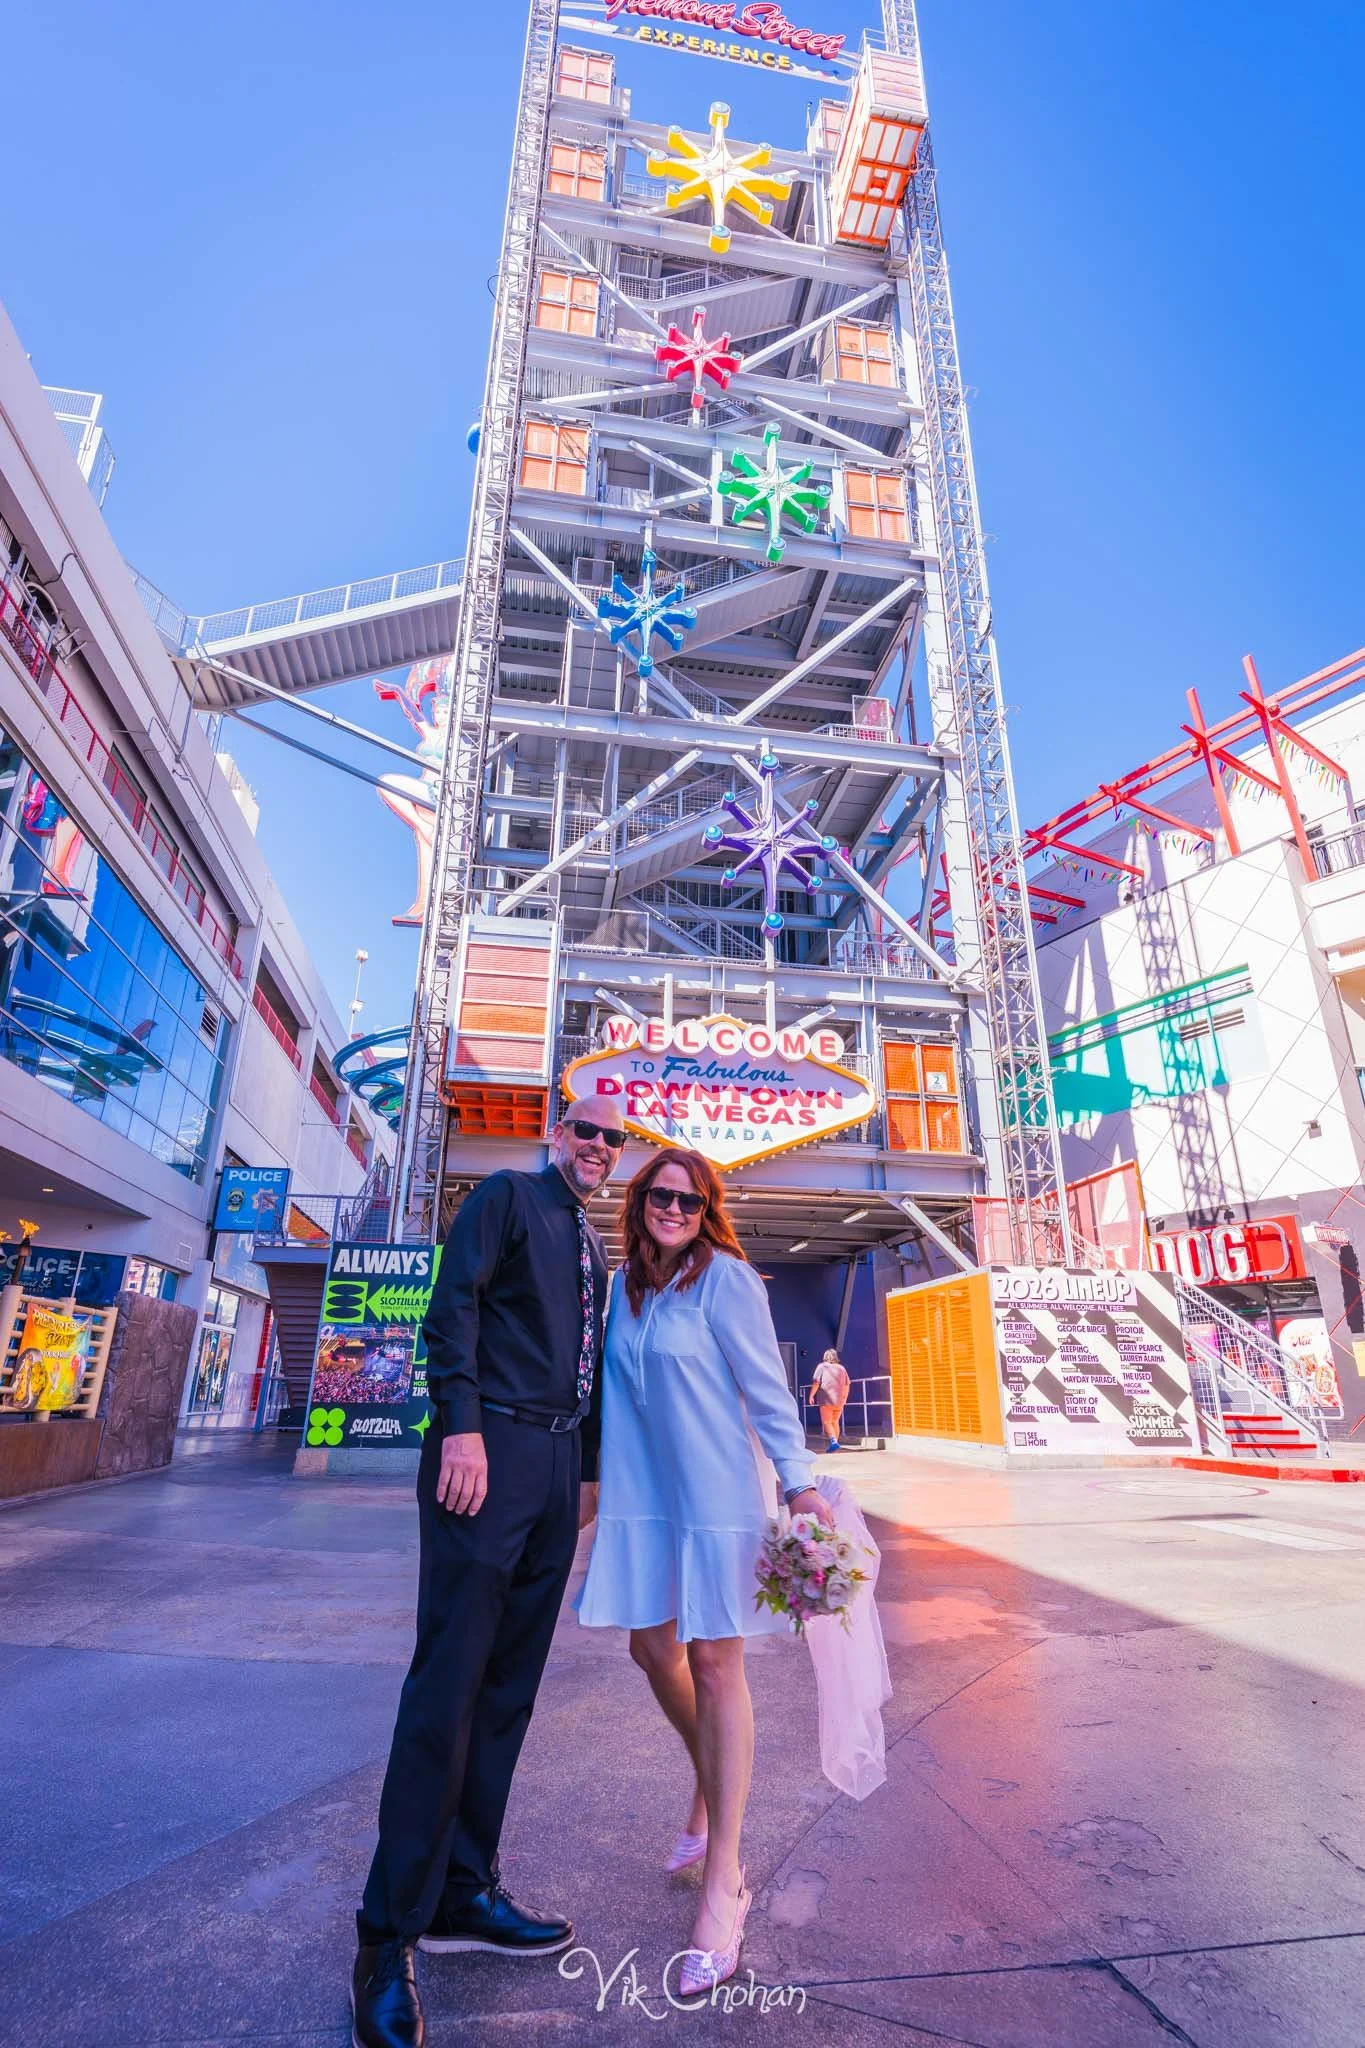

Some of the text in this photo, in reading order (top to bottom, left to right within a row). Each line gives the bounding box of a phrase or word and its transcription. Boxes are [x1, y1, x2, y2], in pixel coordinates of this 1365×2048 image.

[732, 3, 846, 60] Street
[638, 26, 792, 70] EXPERIENCE
[607, 1021, 836, 1057] WELCOME
[631, 1055, 794, 1083] TO Fabulous
[933, 1075, 941, 1085] 2
[596, 1078, 844, 1109] DOWNTOWN
[626, 1099, 817, 1126] LAS VEGAS
[671, 1125, 774, 1143] NEVADA
[228, 1170, 283, 1182] POLICE
[333, 1249, 430, 1276] ALWAYS
[996, 1276, 1133, 1303] 2026 LINEUP
[380, 1297, 420, 1306] SLOTZILLA
[1014, 1323, 1034, 1331] BRICE
[1057, 1325, 1086, 1333] GEORGE
[1116, 1326, 1145, 1334] PROTOJE
[1059, 1345, 1089, 1353] SLEEPING
[1118, 1344, 1163, 1352] CARLY PEARCE
[1006, 1355, 1046, 1364] CROSSFADE
[1063, 1375, 1117, 1384] MAYDAY PARADE
[1010, 1384, 1025, 1392] FUEL
[1088, 1397, 1098, 1405] OF
[1011, 1405, 1059, 1414] FINGER ELEVEN
[1080, 1406, 1096, 1414] YEAR
[1129, 1415, 1176, 1428] SUMMER
[1027, 1431, 1038, 1439] SEE
[1126, 1429, 1185, 1438] CONCERT SERIES
